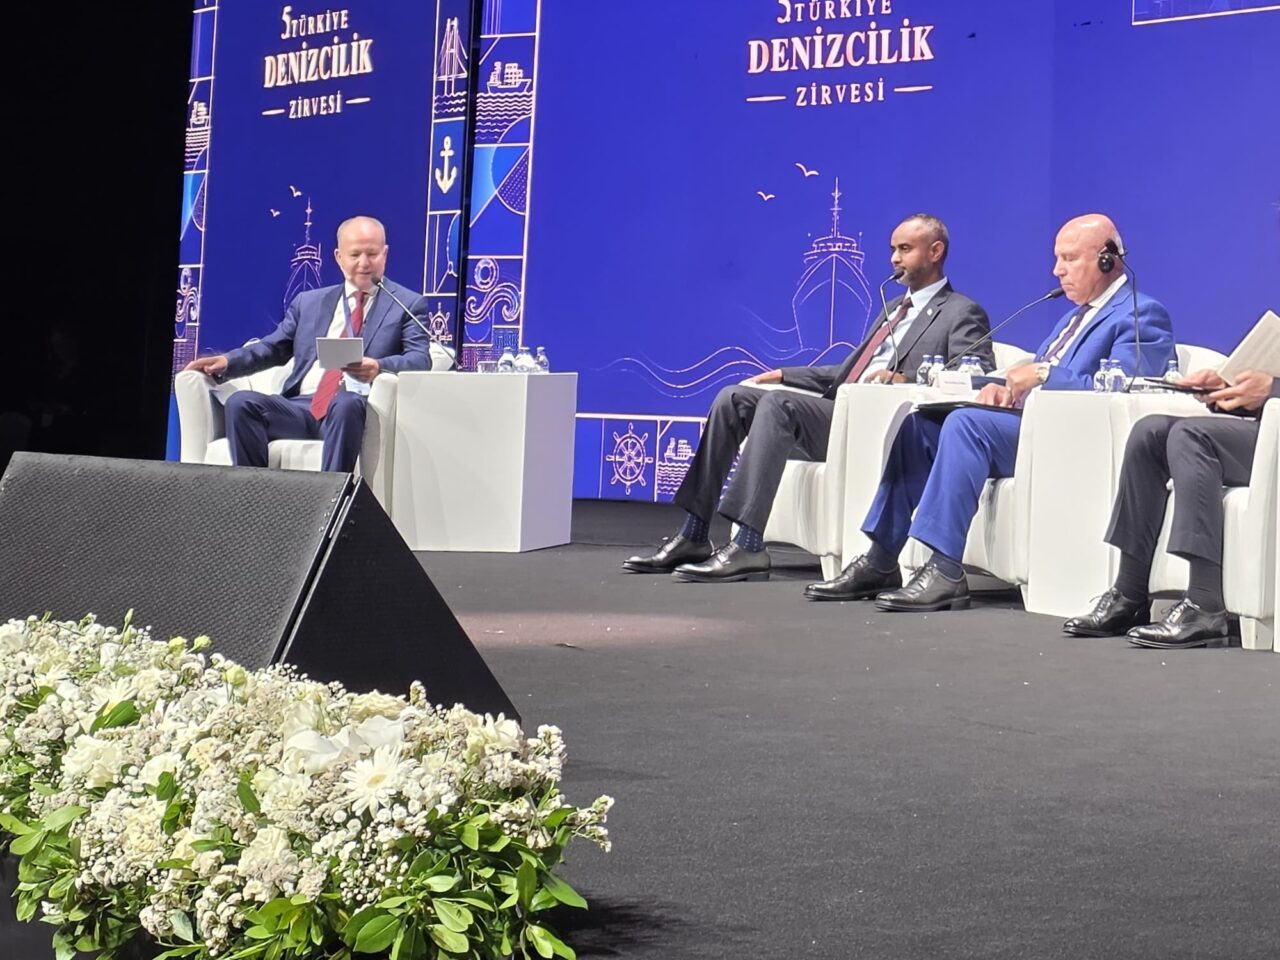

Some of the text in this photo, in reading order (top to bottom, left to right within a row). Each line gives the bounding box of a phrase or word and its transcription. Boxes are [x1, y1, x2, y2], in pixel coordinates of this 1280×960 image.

[263, 32, 374, 88] DENİZCİLİK
[747, 18, 935, 74] DENİZCİLİK
[288, 90, 342, 119] ZİRVESİ
[795, 77, 885, 107] ZİRVESİ
